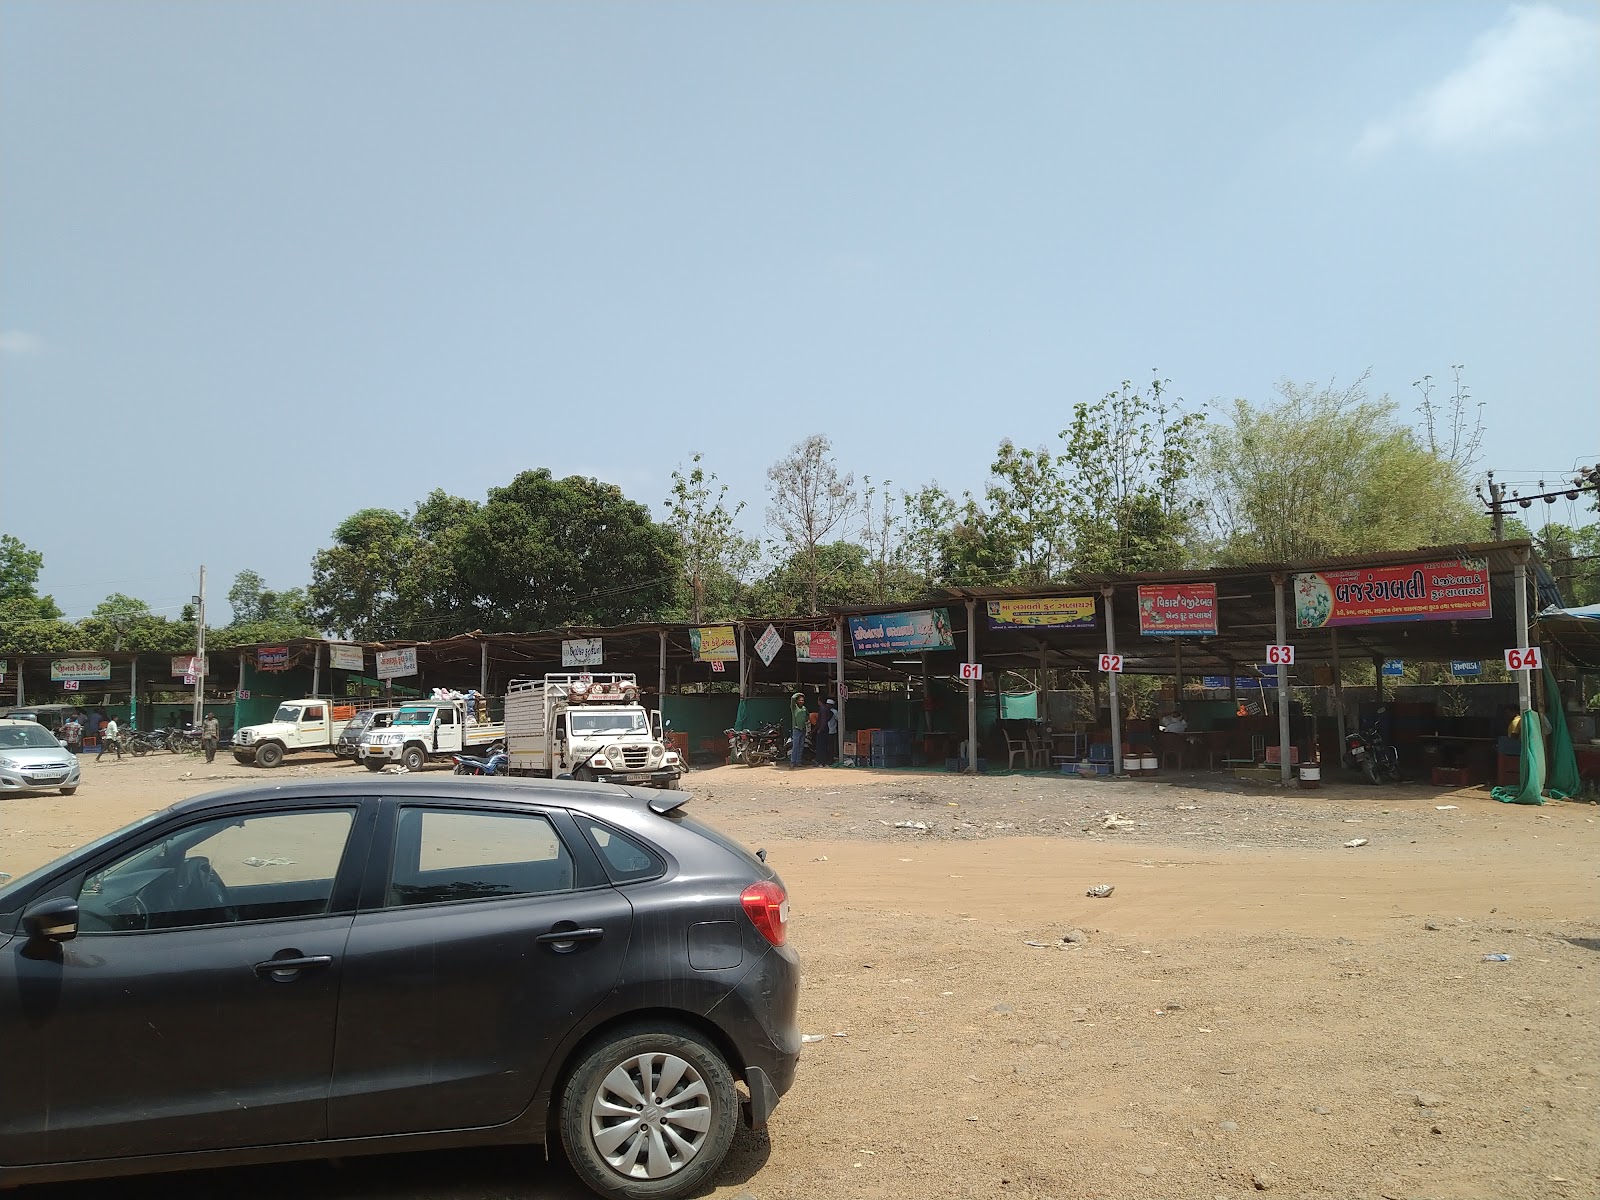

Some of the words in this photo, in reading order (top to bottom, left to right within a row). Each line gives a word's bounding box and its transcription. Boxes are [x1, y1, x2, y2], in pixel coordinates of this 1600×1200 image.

[1336, 569, 1427, 603] બજરંગબલી
[1157, 596, 1179, 608] વિકાસ
[1181, 596, 1213, 609] વેજીટેબલ
[1269, 647, 1291, 664] 63
[1508, 648, 1538, 669] 64
[713, 661, 723, 671] 59
[962, 664, 979, 679] 61
[1101, 656, 1121, 672] 62
[65, 680, 78, 689] 54
[840, 683, 848, 698] 60
[240, 690, 249, 699] 56
